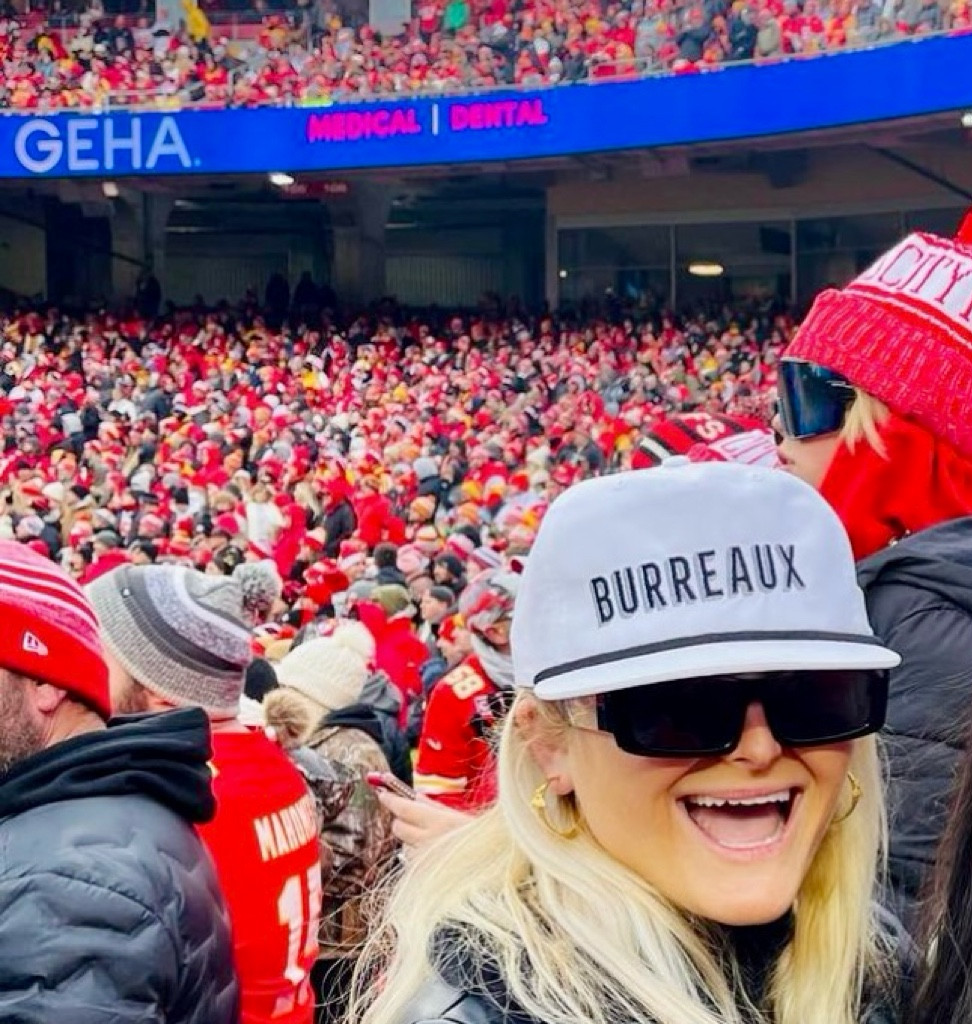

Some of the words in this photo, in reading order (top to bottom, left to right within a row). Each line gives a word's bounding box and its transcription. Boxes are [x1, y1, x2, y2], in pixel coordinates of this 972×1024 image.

[307, 108, 421, 143] MEDICAL
[451, 98, 548, 130] DENTAL
[590, 544, 805, 625] BURREAUX
